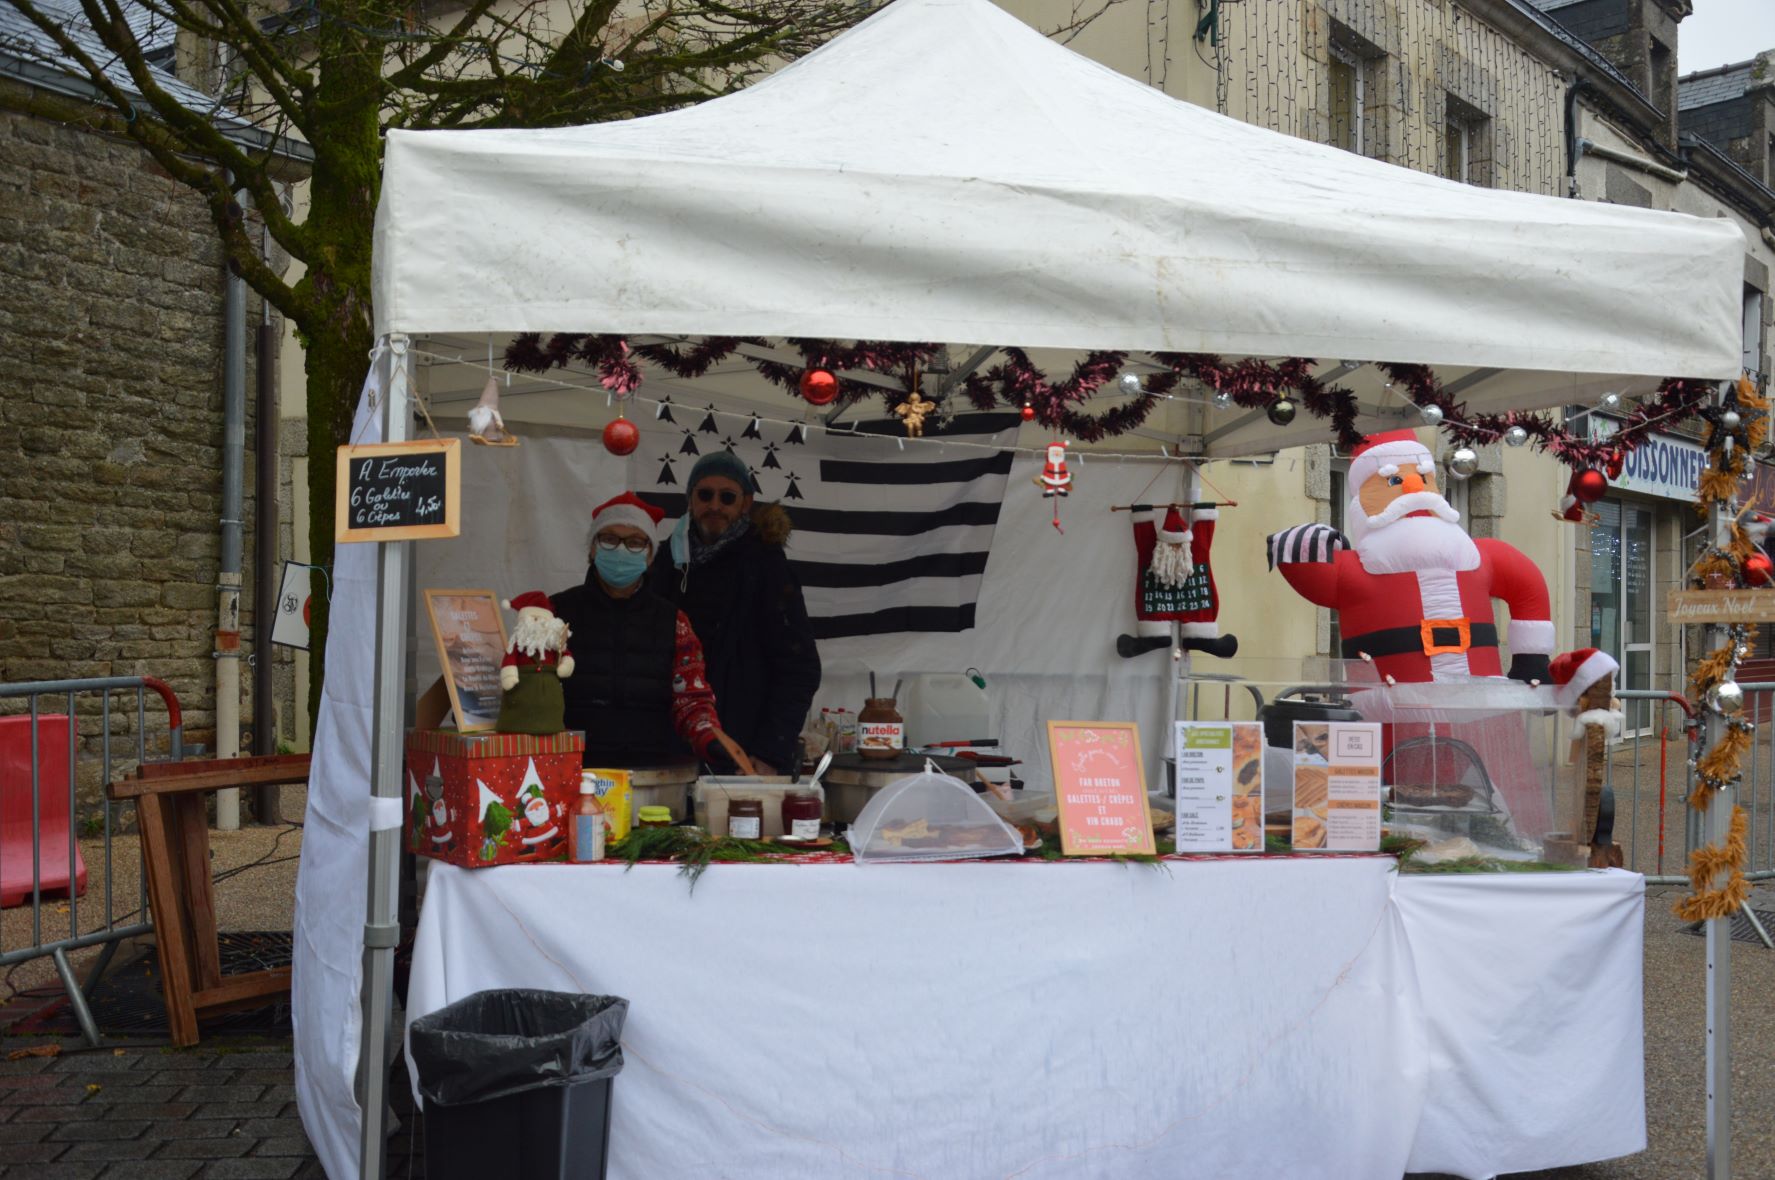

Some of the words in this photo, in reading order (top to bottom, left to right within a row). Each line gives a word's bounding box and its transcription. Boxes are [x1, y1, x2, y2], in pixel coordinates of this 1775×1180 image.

[358, 458, 373, 481] A
[378, 457, 438, 485] Emporter
[1624, 439, 1711, 491] OISSONNER
[350, 486, 363, 507] 6
[356, 508, 366, 523] 6
[1673, 598, 1718, 617] Joyeux
[862, 724, 900, 735] nutella
[1078, 777, 1093, 787] FAR
[1094, 777, 1121, 788] BRETON
[1066, 793, 1101, 805] GALETTES
[1108, 793, 1135, 805] CRÊPES
[1098, 805, 1107, 815] ET
[1086, 816, 1100, 826] VIN
[1100, 816, 1124, 827] CHAUD
